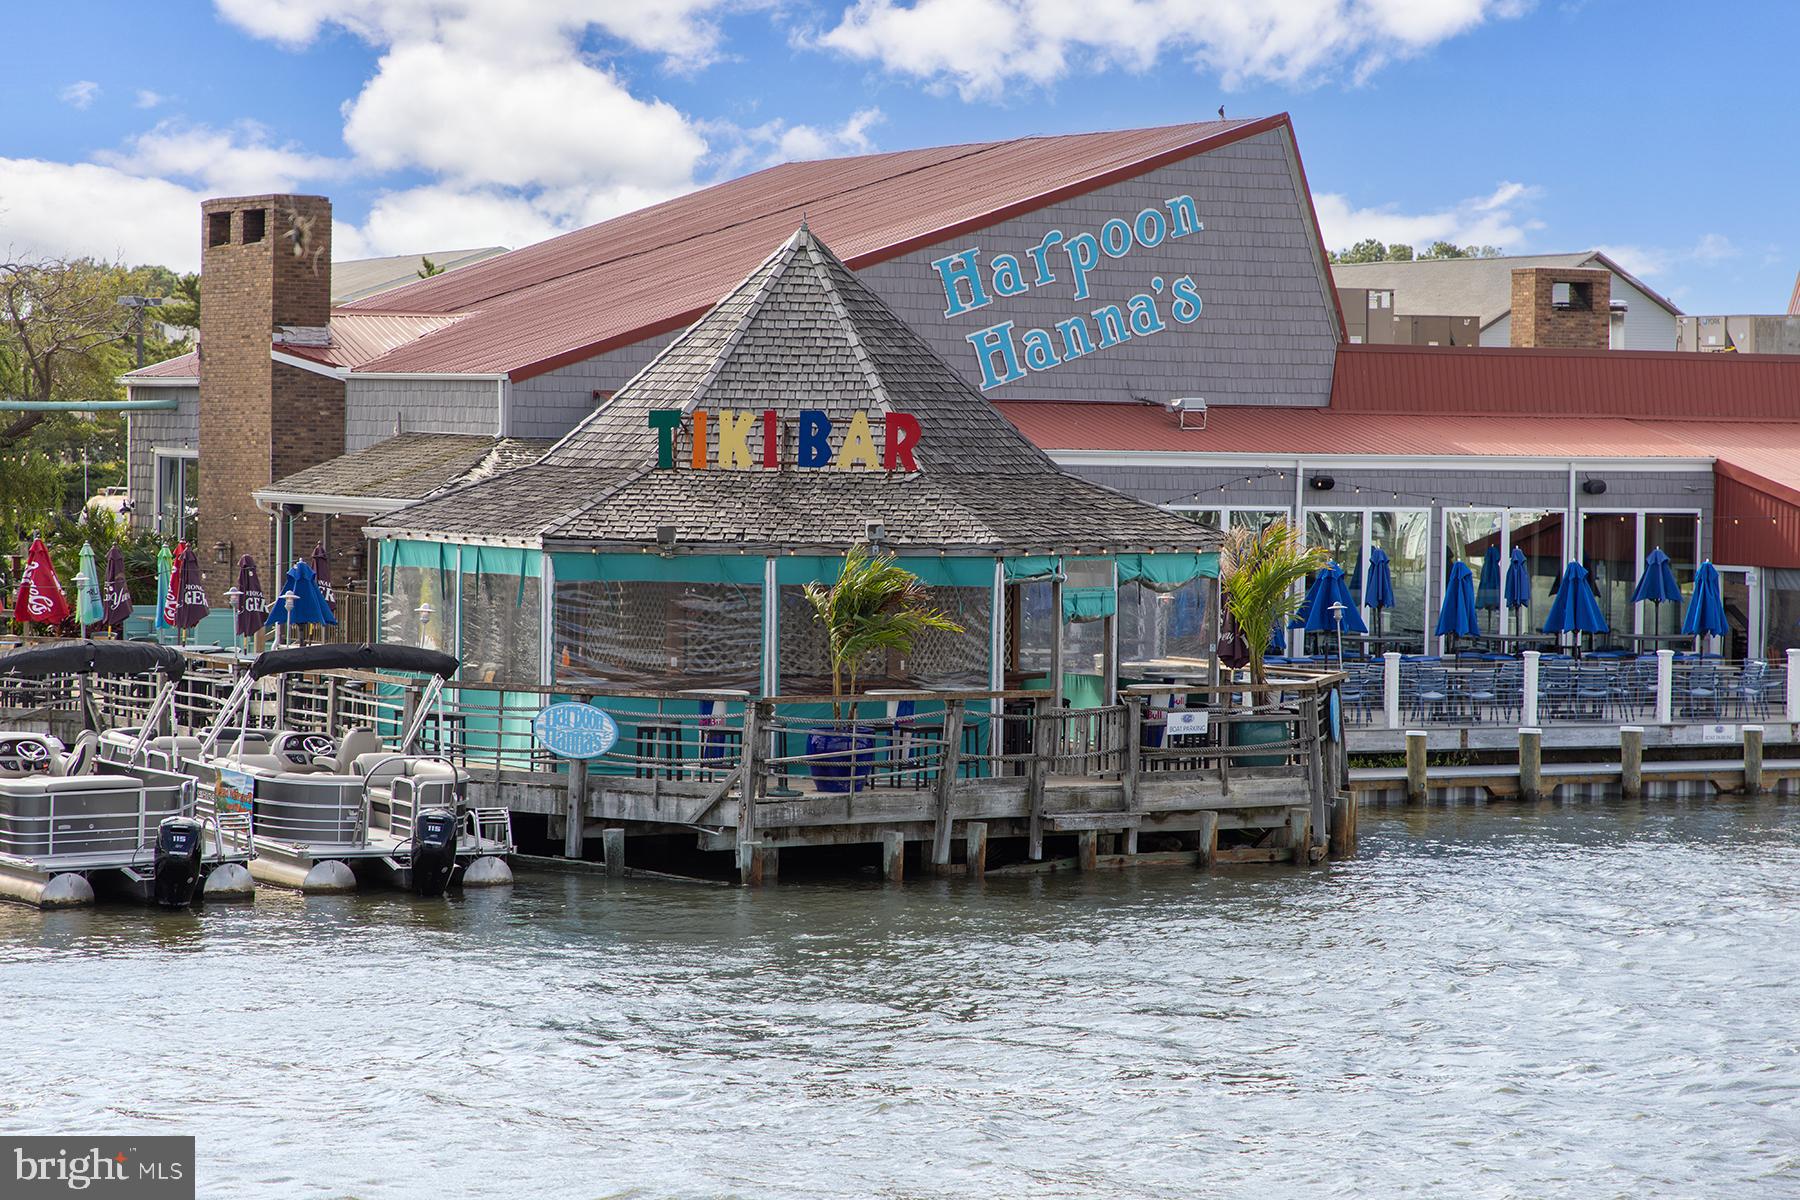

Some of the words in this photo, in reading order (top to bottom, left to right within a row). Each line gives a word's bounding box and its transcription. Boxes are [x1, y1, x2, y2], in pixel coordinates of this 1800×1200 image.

[931, 195, 1204, 319] Harpoon
[965, 274, 1203, 392] Hanna's
[648, 409, 778, 469] TIKI
[798, 410, 922, 473] BAR
[1183, 724, 1206, 732] PARKING
[172, 835, 187, 843] 115
